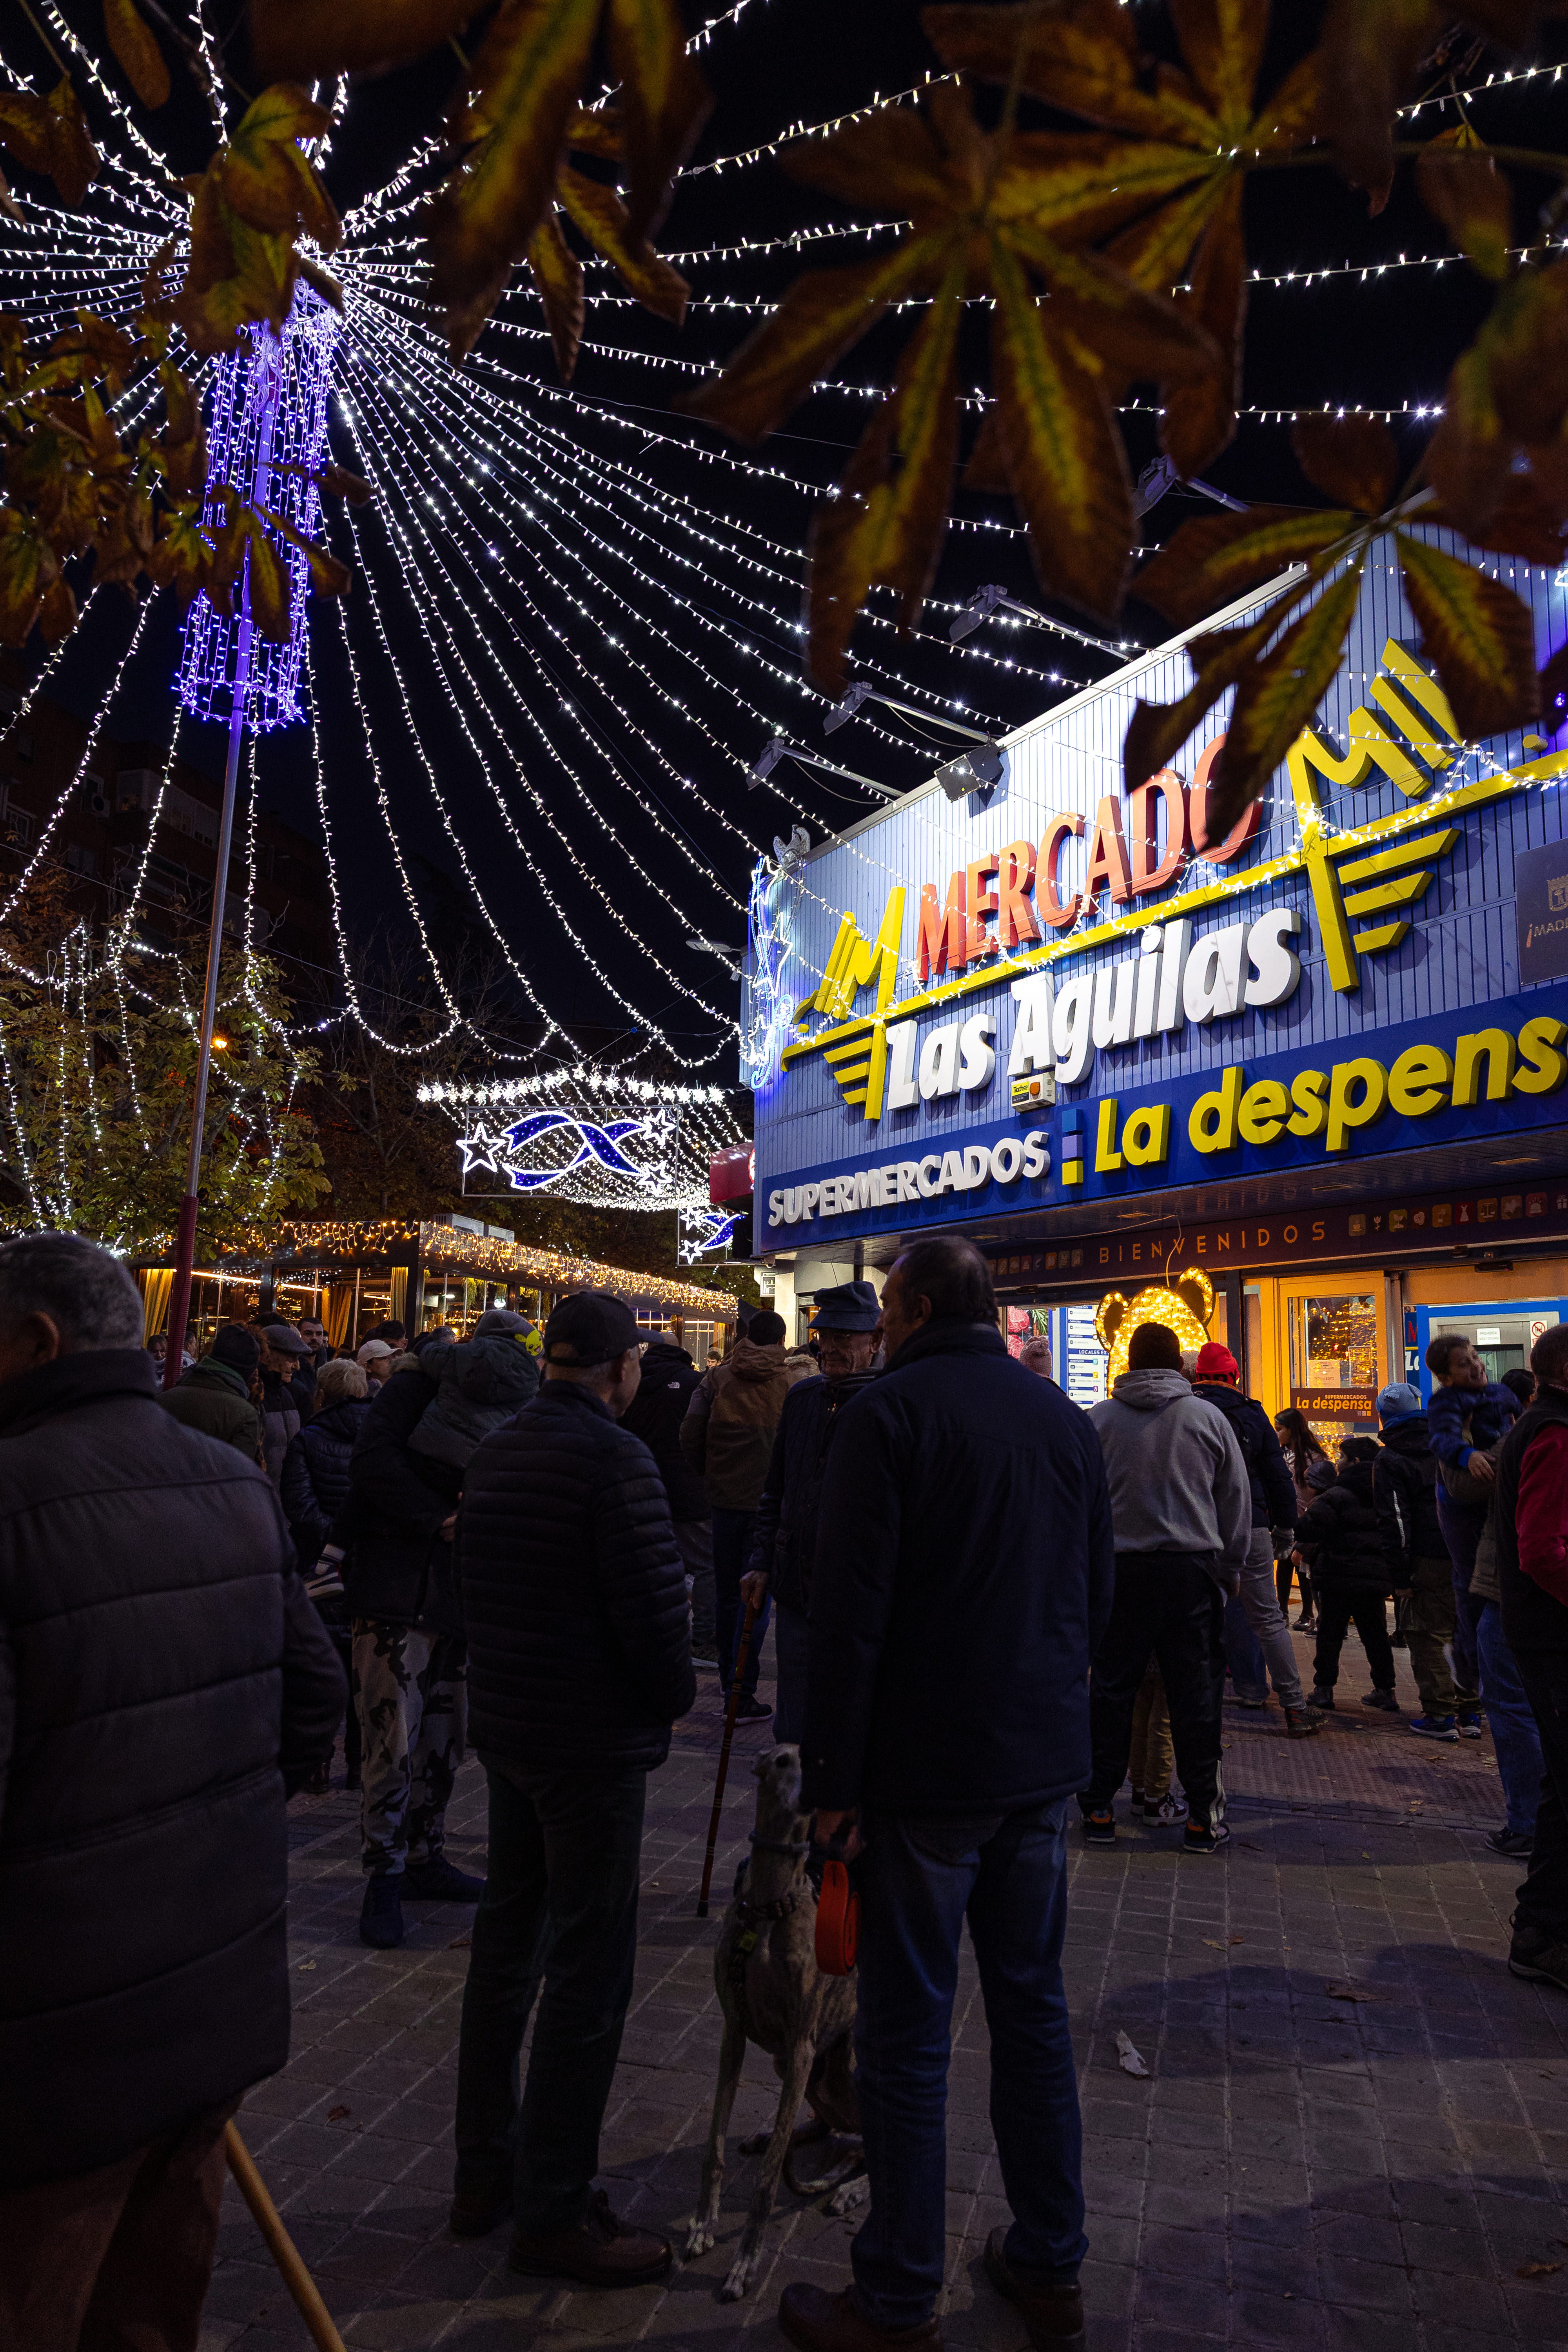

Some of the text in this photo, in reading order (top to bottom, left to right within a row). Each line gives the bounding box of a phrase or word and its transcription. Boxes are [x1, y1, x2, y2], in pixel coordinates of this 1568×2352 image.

[916, 731, 1264, 982] MERCADO
[886, 907, 1301, 1111] Las Aguilas
[768, 1017, 1568, 1226] SUPERMERCADOS La despens
[1099, 1221, 1325, 1263] BIENVENIDOS
[1296, 1396, 1372, 1412] La despensa
